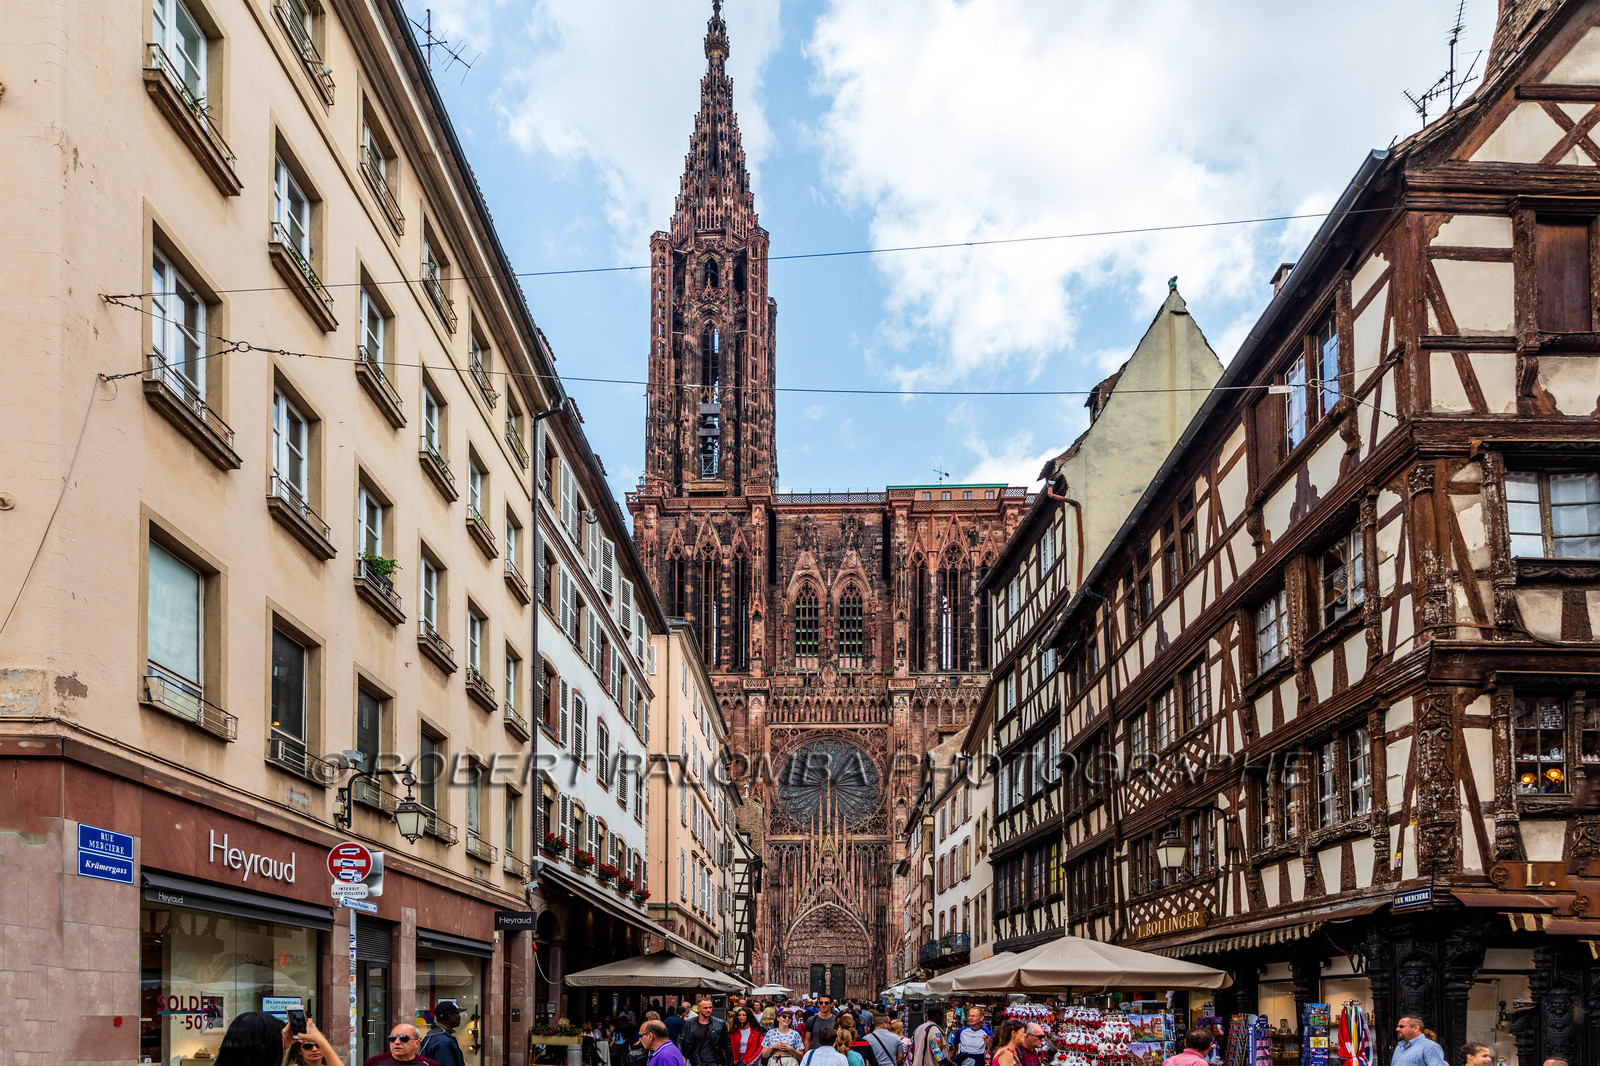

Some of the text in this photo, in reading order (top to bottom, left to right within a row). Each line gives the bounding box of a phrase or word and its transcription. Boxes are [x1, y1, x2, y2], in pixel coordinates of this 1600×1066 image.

[100, 832, 115, 843] RUE
[208, 829, 296, 884] Heyraud
[85, 859, 128, 875] Krämergass
[1525, 863, 1556, 887] L.
[158, 891, 184, 904] Heyraud
[498, 916, 532, 926] Heyraud
[156, 994, 217, 1012] SOLDES
[180, 1014, 214, 1030] -50%
